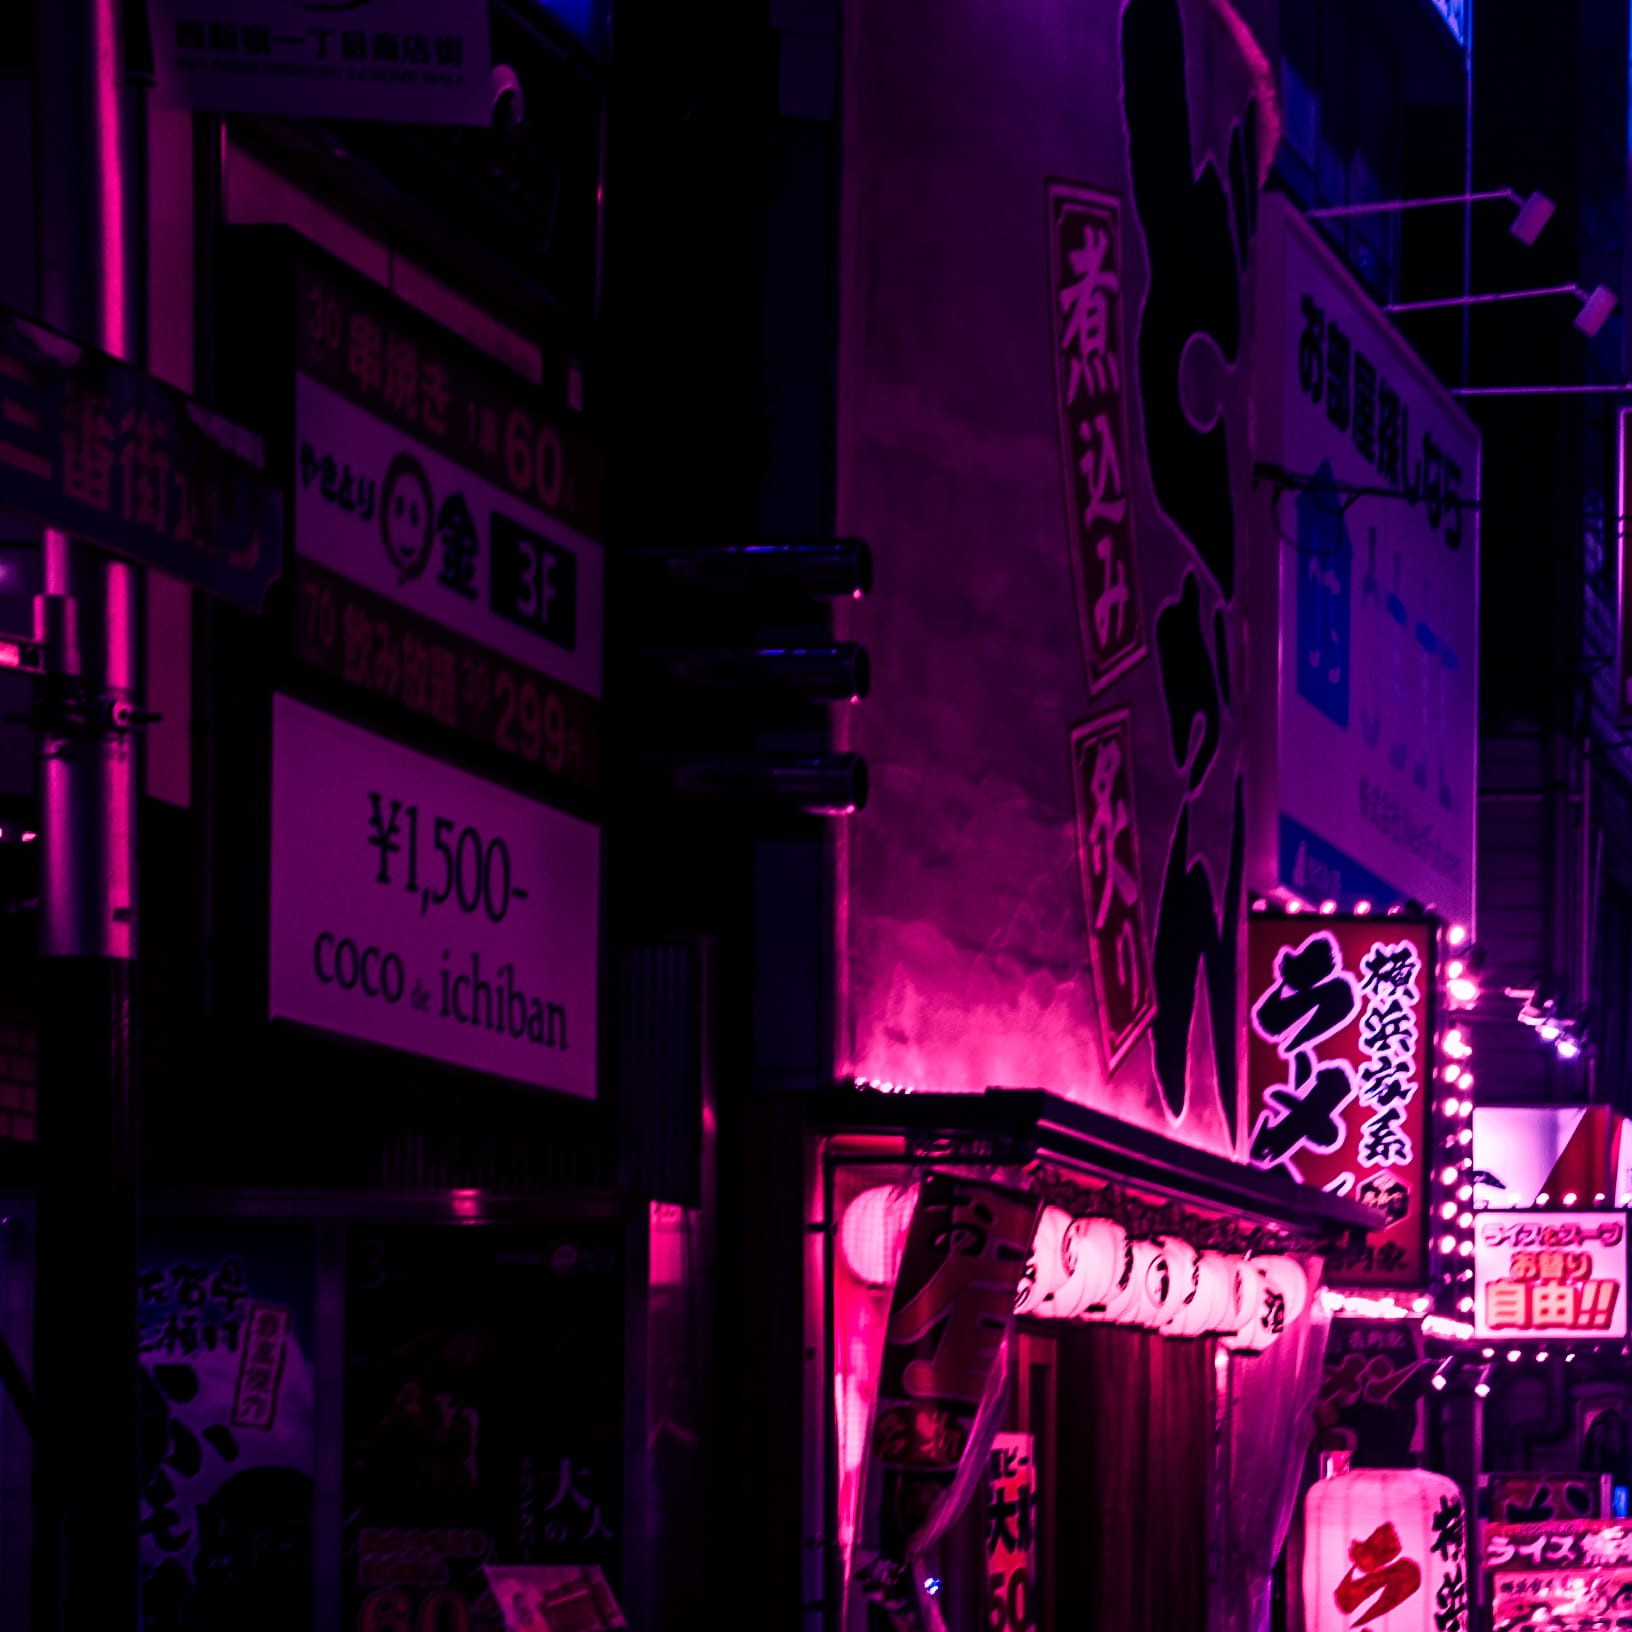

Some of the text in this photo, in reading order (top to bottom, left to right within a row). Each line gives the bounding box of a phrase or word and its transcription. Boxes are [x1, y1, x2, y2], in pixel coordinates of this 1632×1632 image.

[516, 539, 558, 624] 3F
[368, 791, 528, 923] ¥1,500-
[313, 930, 403, 1004] coco
[440, 947, 569, 1053] ichiban
[1358, 940, 1420, 1168] 横浜家系
[1485, 1534, 1577, 1567] ライス
